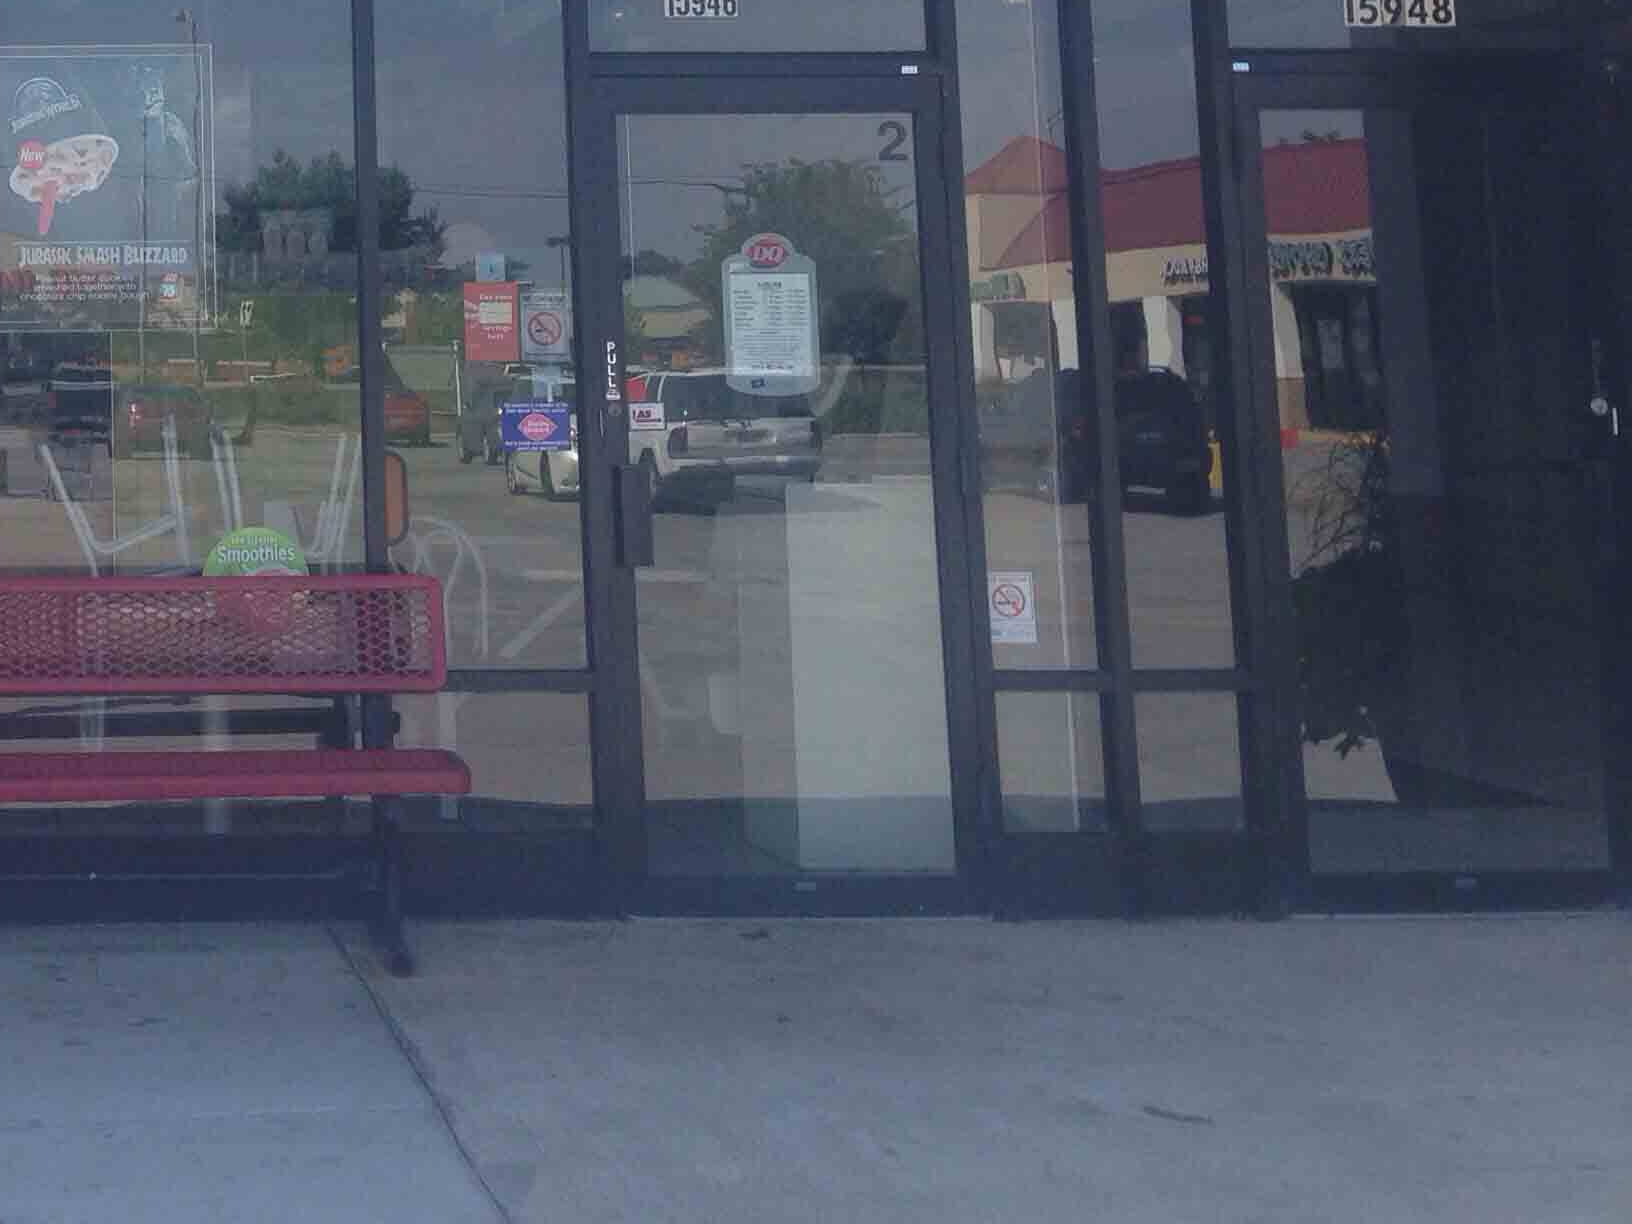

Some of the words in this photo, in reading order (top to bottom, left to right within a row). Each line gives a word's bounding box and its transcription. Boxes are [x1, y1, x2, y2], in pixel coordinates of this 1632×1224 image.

[878, 121, 908, 161] 2
[19, 149, 45, 162] New
[18, 246, 72, 265] JURASSIC
[75, 246, 119, 264] SMASH
[123, 245, 188, 264] BLIZZARD
[606, 341, 618, 388] PULL
[215, 543, 296, 563] Smoothies
